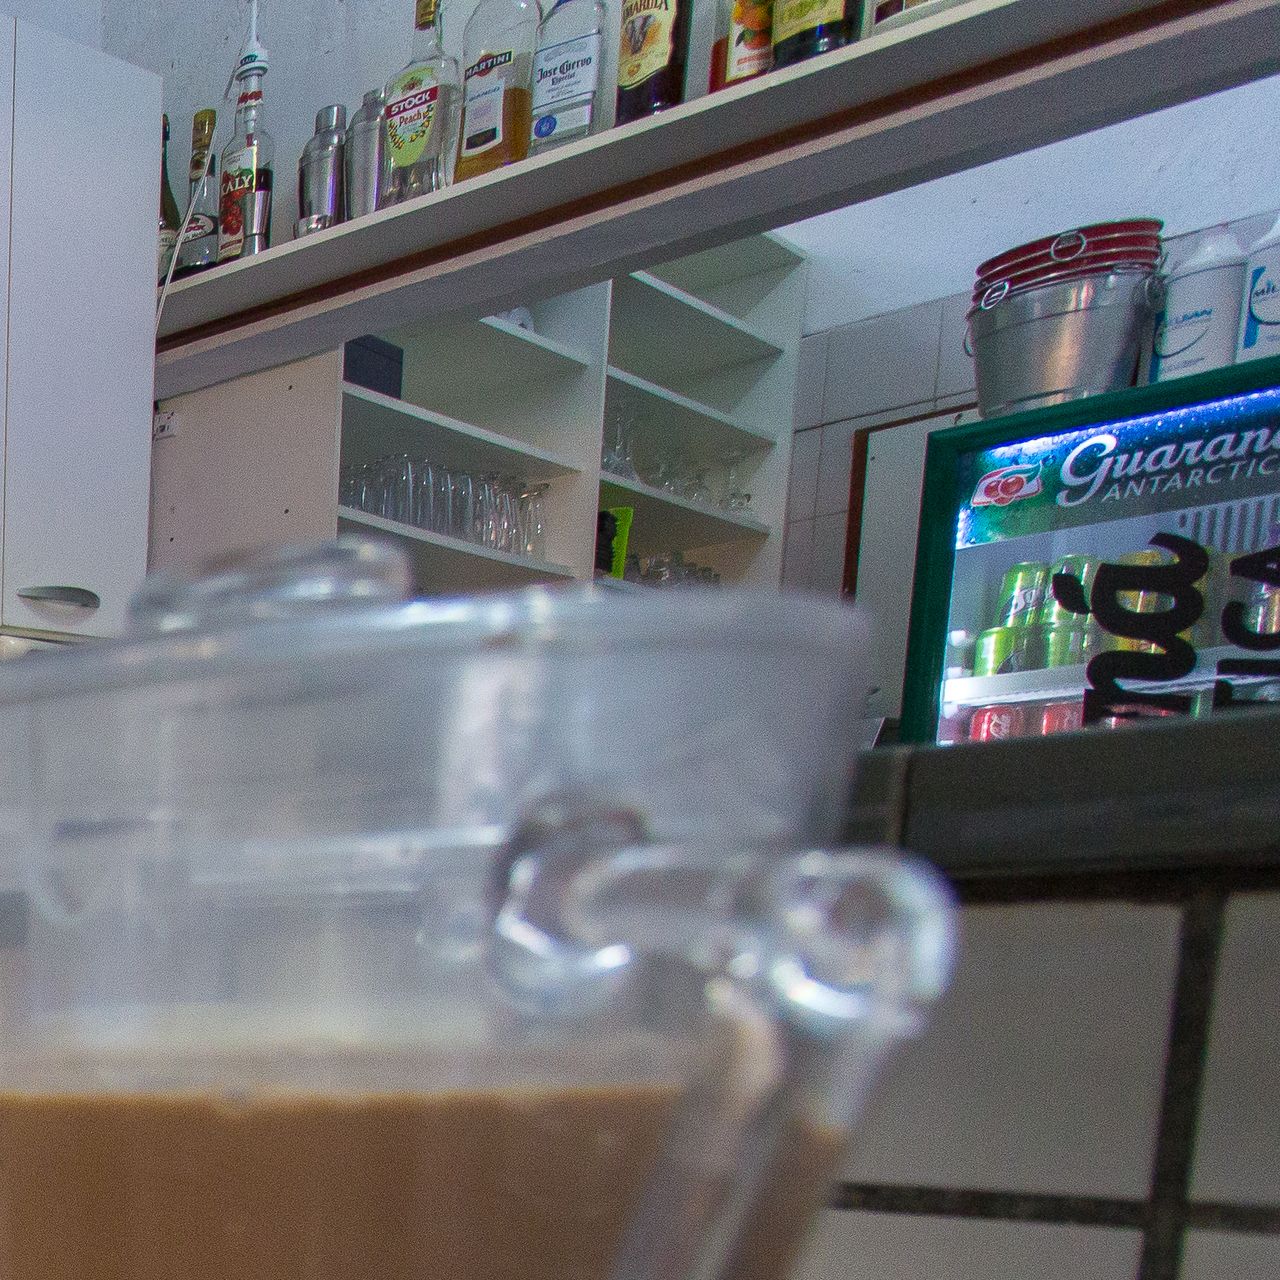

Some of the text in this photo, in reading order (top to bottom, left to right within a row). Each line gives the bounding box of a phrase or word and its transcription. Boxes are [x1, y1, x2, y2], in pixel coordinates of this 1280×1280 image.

[465, 54, 511, 78] MARTINI
[536, 56, 592, 84] Jose Cuervo
[391, 91, 431, 115] STOCK
[399, 110, 422, 127] Peach
